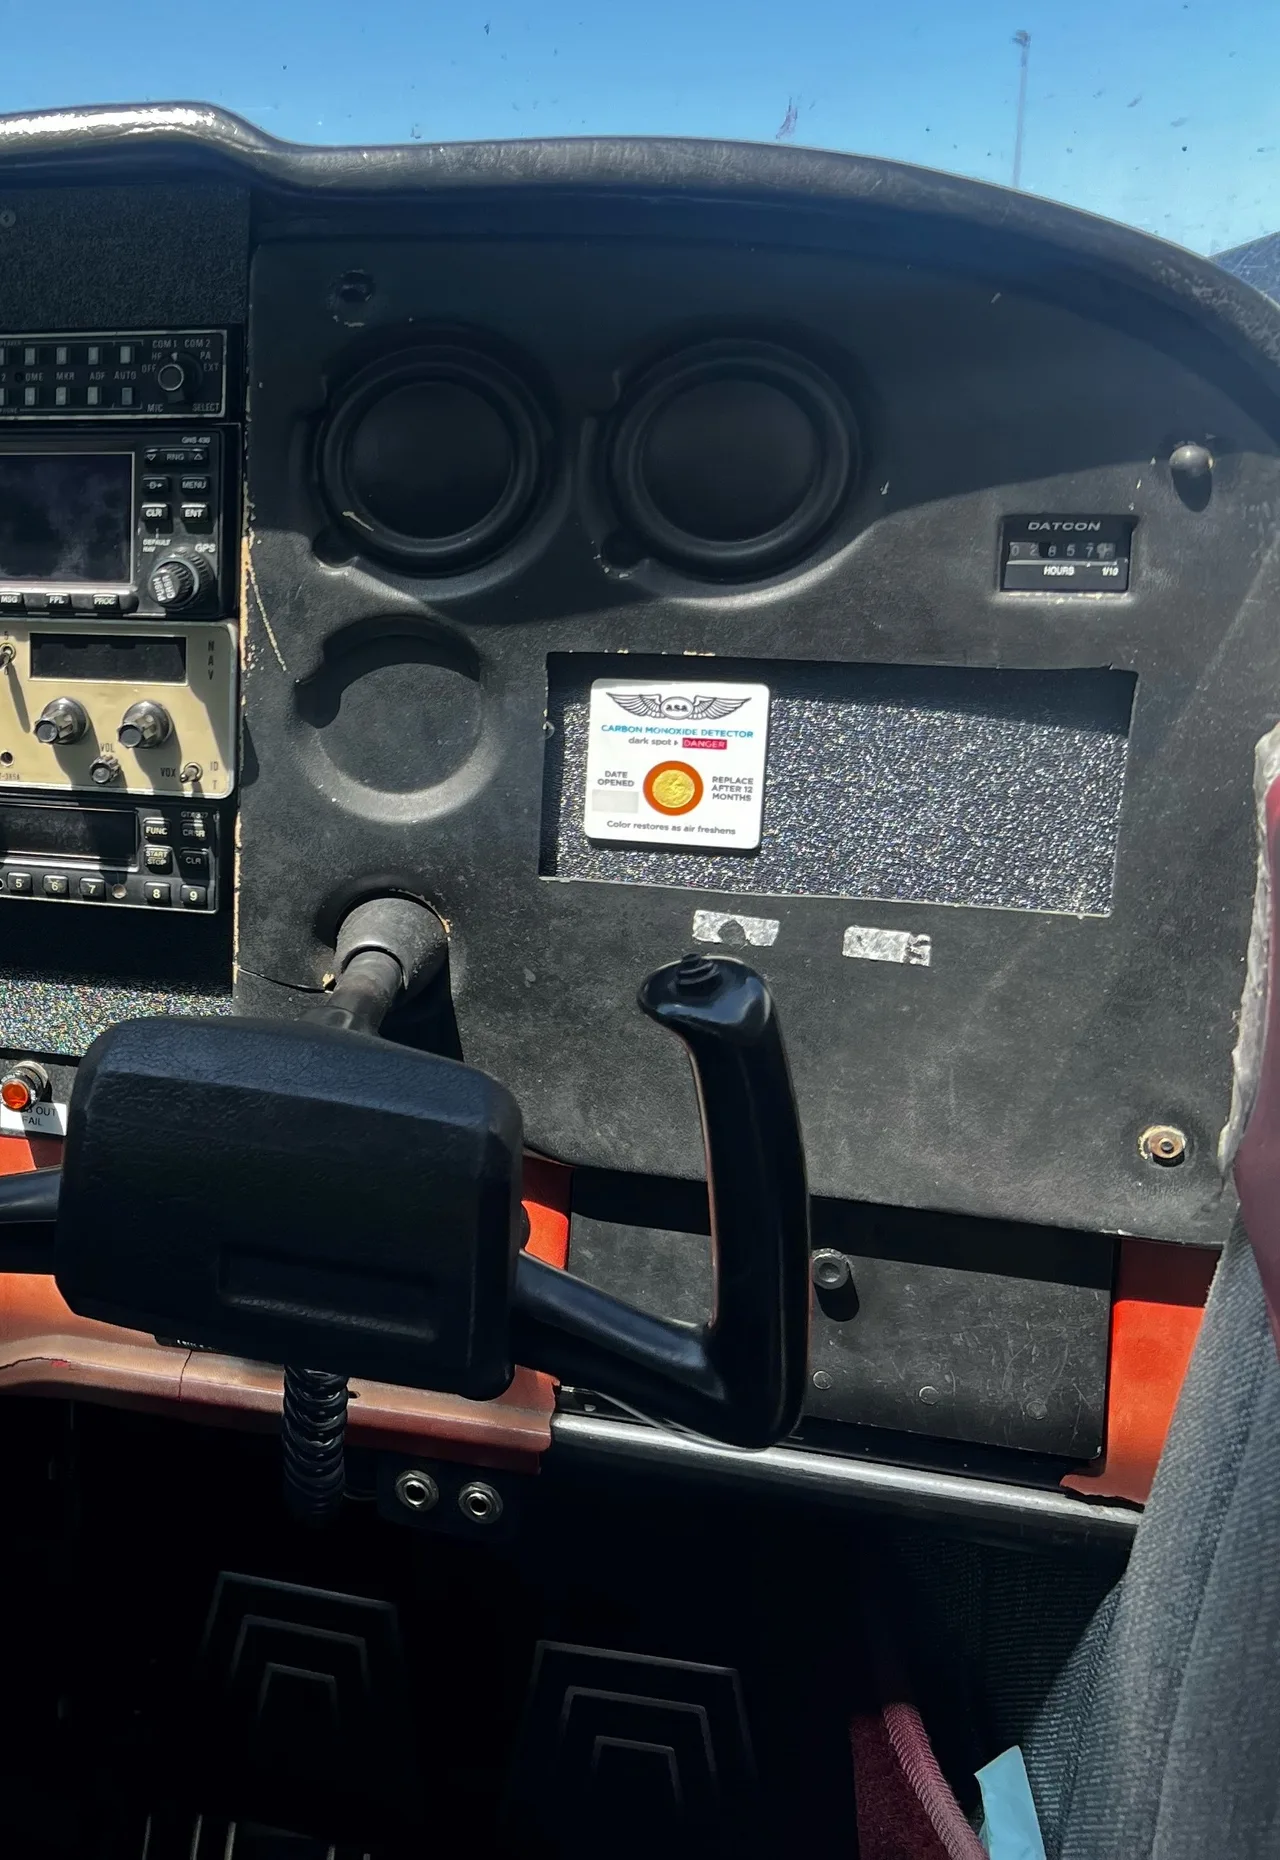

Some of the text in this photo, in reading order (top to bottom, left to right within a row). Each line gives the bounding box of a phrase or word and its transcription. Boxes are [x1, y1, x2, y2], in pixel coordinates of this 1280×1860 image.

[152, 340, 170, 348] COM
[185, 339, 202, 347] COM
[205, 339, 210, 347] 2
[200, 352, 211, 360] PA
[142, 365, 156, 373] OFF
[204, 363, 219, 371] EXT
[56, 372, 74, 380] MKR
[90, 372, 105, 380] ADF
[115, 371, 136, 379] AUTO
[147, 404, 163, 412] MIC
[192, 403, 219, 411] SELECT
[182, 481, 207, 489] MENU
[146, 509, 162, 517] CLR
[185, 509, 203, 517] ENT
[1028, 522, 1101, 531] DATCON
[195, 544, 215, 553] GPS
[1044, 566, 1119, 576] HOURS 1/10
[153, 578, 166, 601] PUSH
[1, 595, 18, 603] MSG
[50, 596, 64, 604] FPL
[94, 597, 116, 605] PROC
[601, 724, 754, 738] CARBON MONOXIDE DETECTOR
[628, 737, 726, 748] dark spot DANGER
[101, 744, 115, 752] VOL
[210, 762, 218, 770] ID
[161, 768, 176, 777] VOX
[598, 779, 634, 787] OPENED
[712, 777, 754, 785] REPLACE
[146, 827, 167, 835] FUNC
[607, 820, 631, 828] Color
[633, 822, 669, 831] restores
[698, 825, 736, 835] freshens
[36, 1107, 55, 1116] OUT
